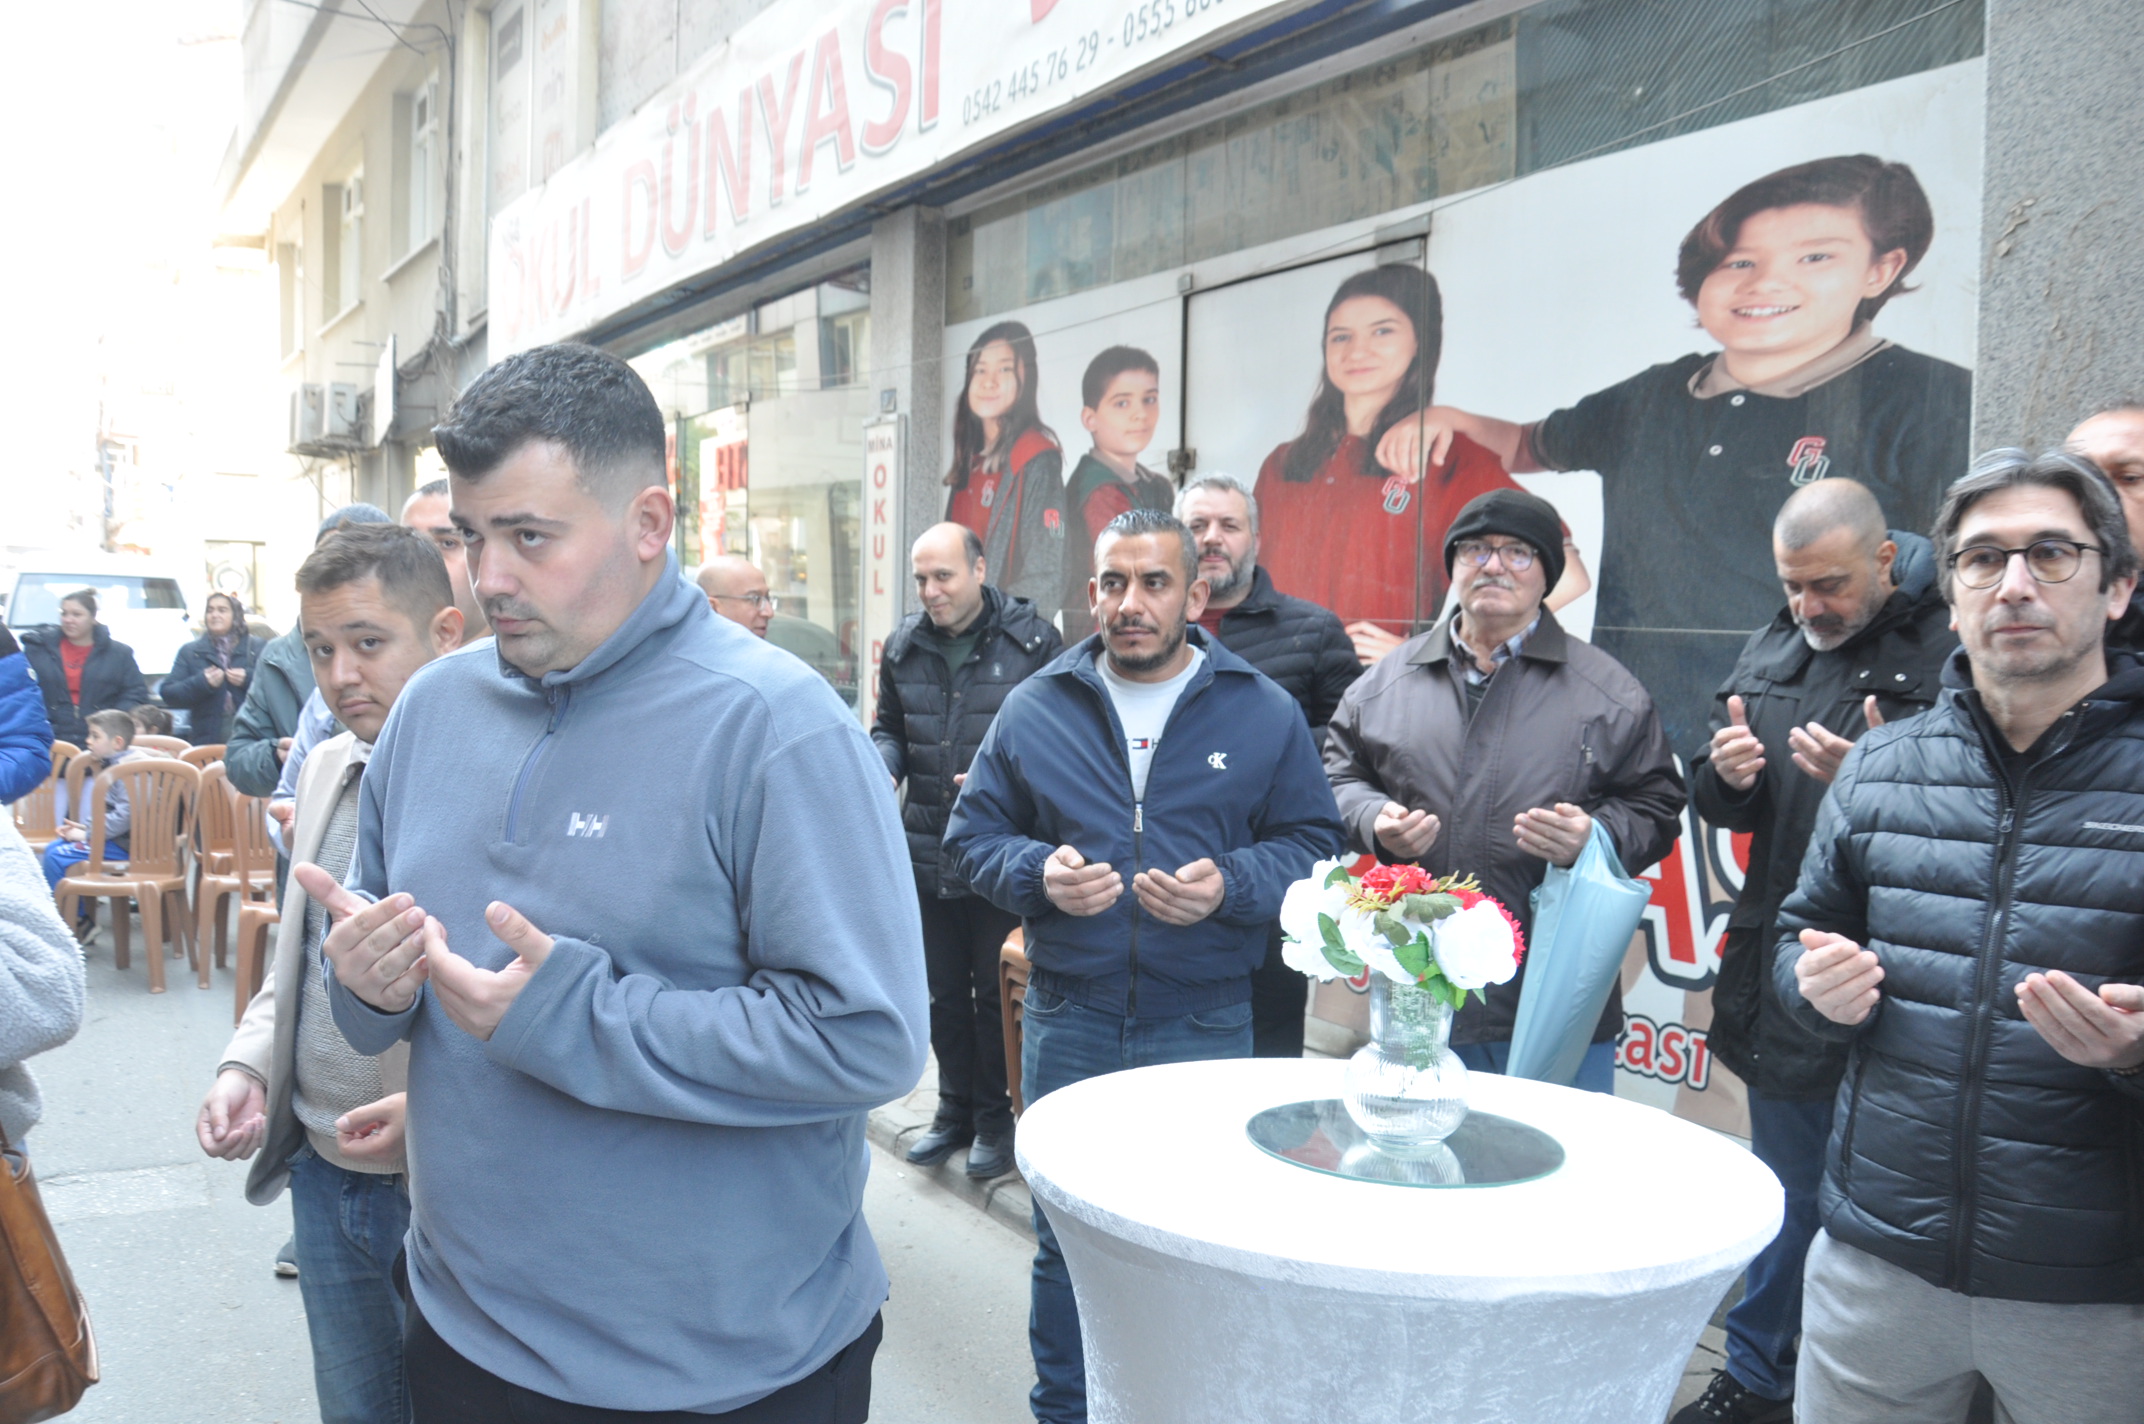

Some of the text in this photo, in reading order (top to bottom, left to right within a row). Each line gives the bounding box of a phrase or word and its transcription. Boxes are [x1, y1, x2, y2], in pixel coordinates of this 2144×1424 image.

[963, 79, 1001, 126] 0542
[1008, 60, 1039, 102] 445
[1047, 46, 1067, 85] 76
[1075, 30, 1099, 72] 29
[1124, 0, 1175, 47] 0555
[501, 0, 943, 341] OKUL DÜNYASI
[867, 434, 893, 453] MİNA
[873, 464, 887, 595] OKUL
[1614, 1016, 1710, 1087] ası
